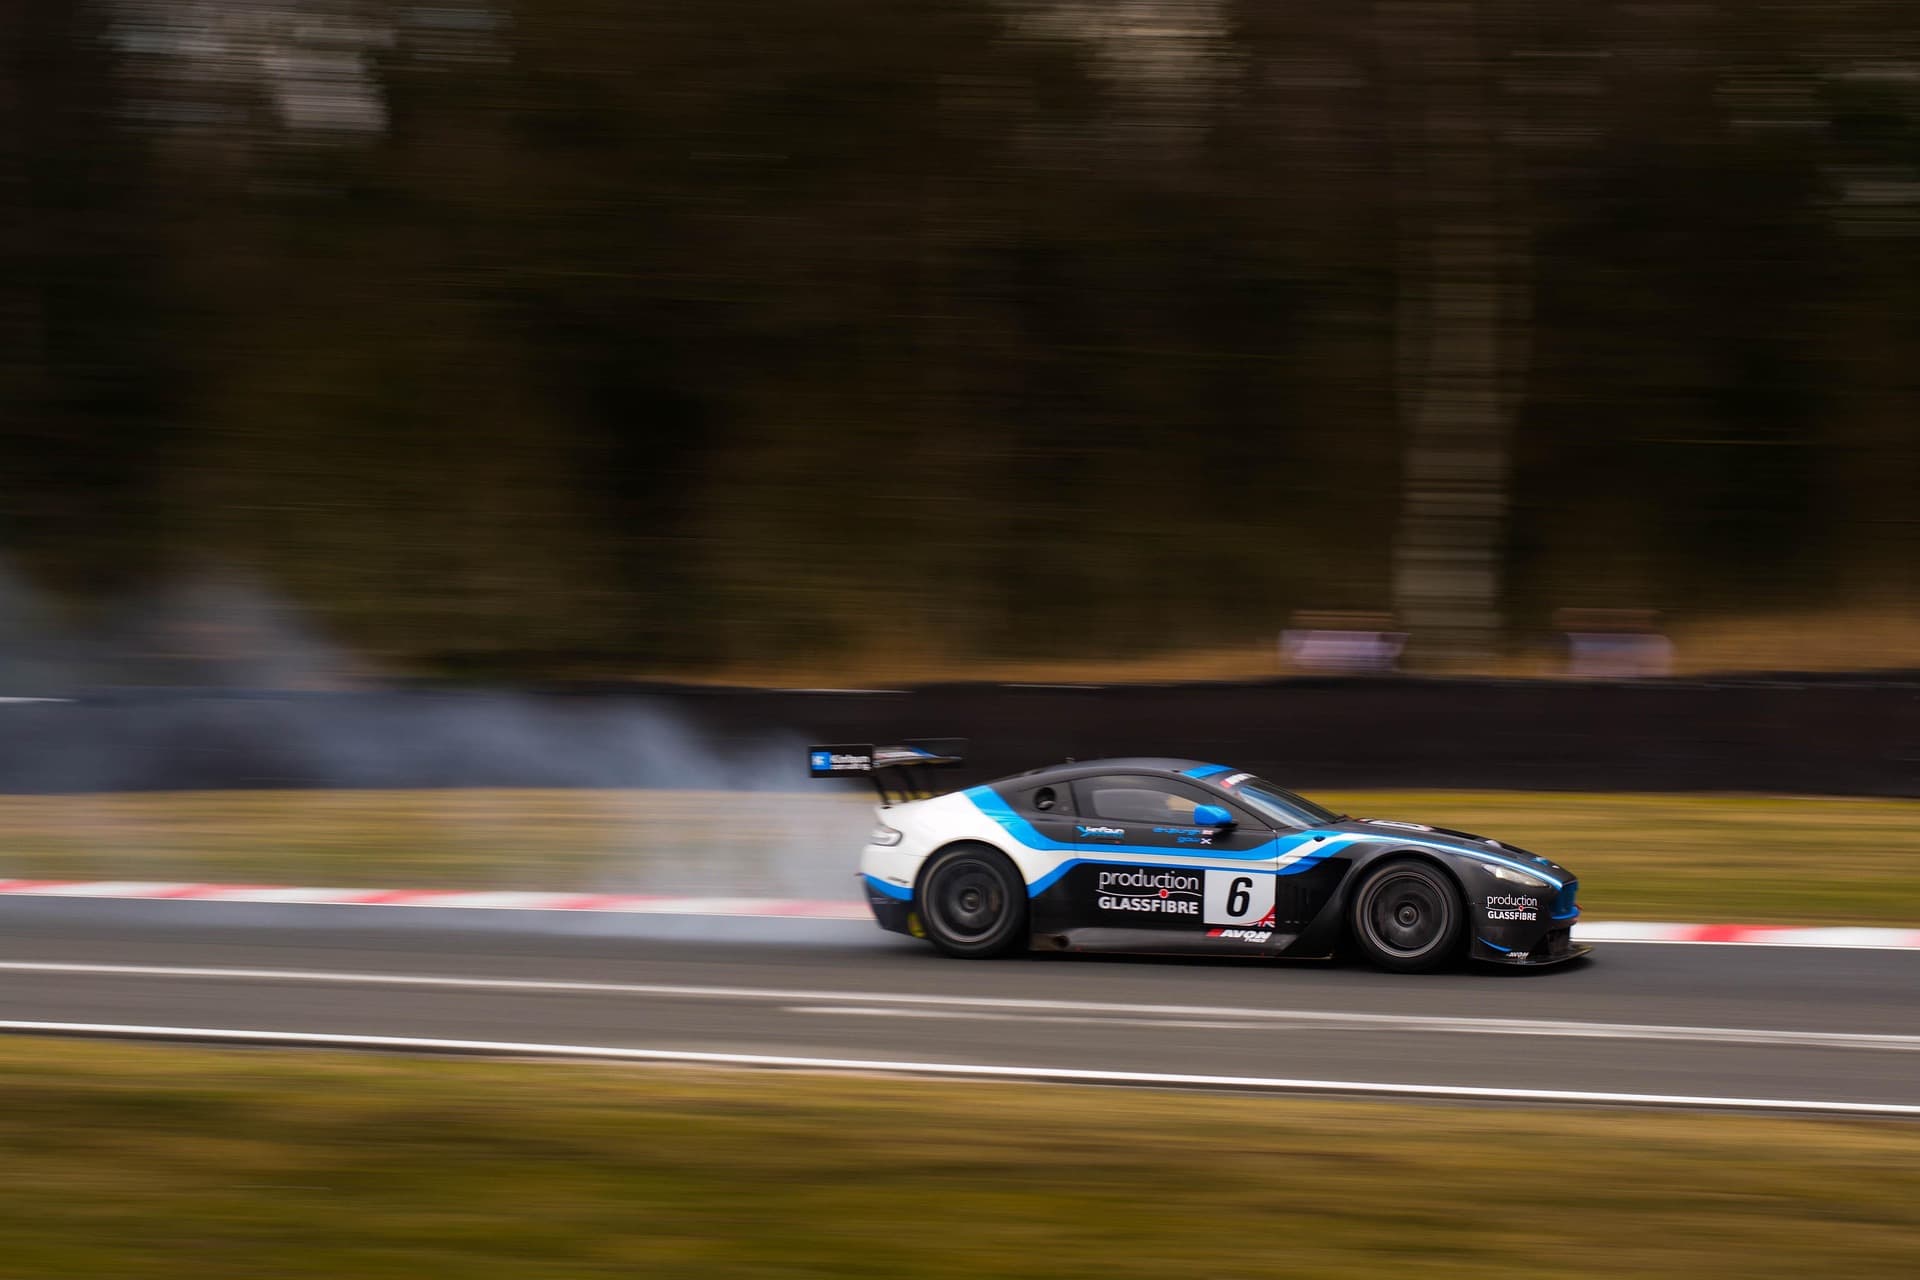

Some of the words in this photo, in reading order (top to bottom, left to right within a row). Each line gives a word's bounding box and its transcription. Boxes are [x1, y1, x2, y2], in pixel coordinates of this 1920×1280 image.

[1099, 868, 1199, 890] production
[1098, 896, 1199, 914] GLASSFIBRE
[1226, 877, 1253, 917] 6
[1486, 893, 1538, 907] production
[1487, 911, 1537, 921] GLASSFIBRE
[1220, 929, 1272, 940] AVON
